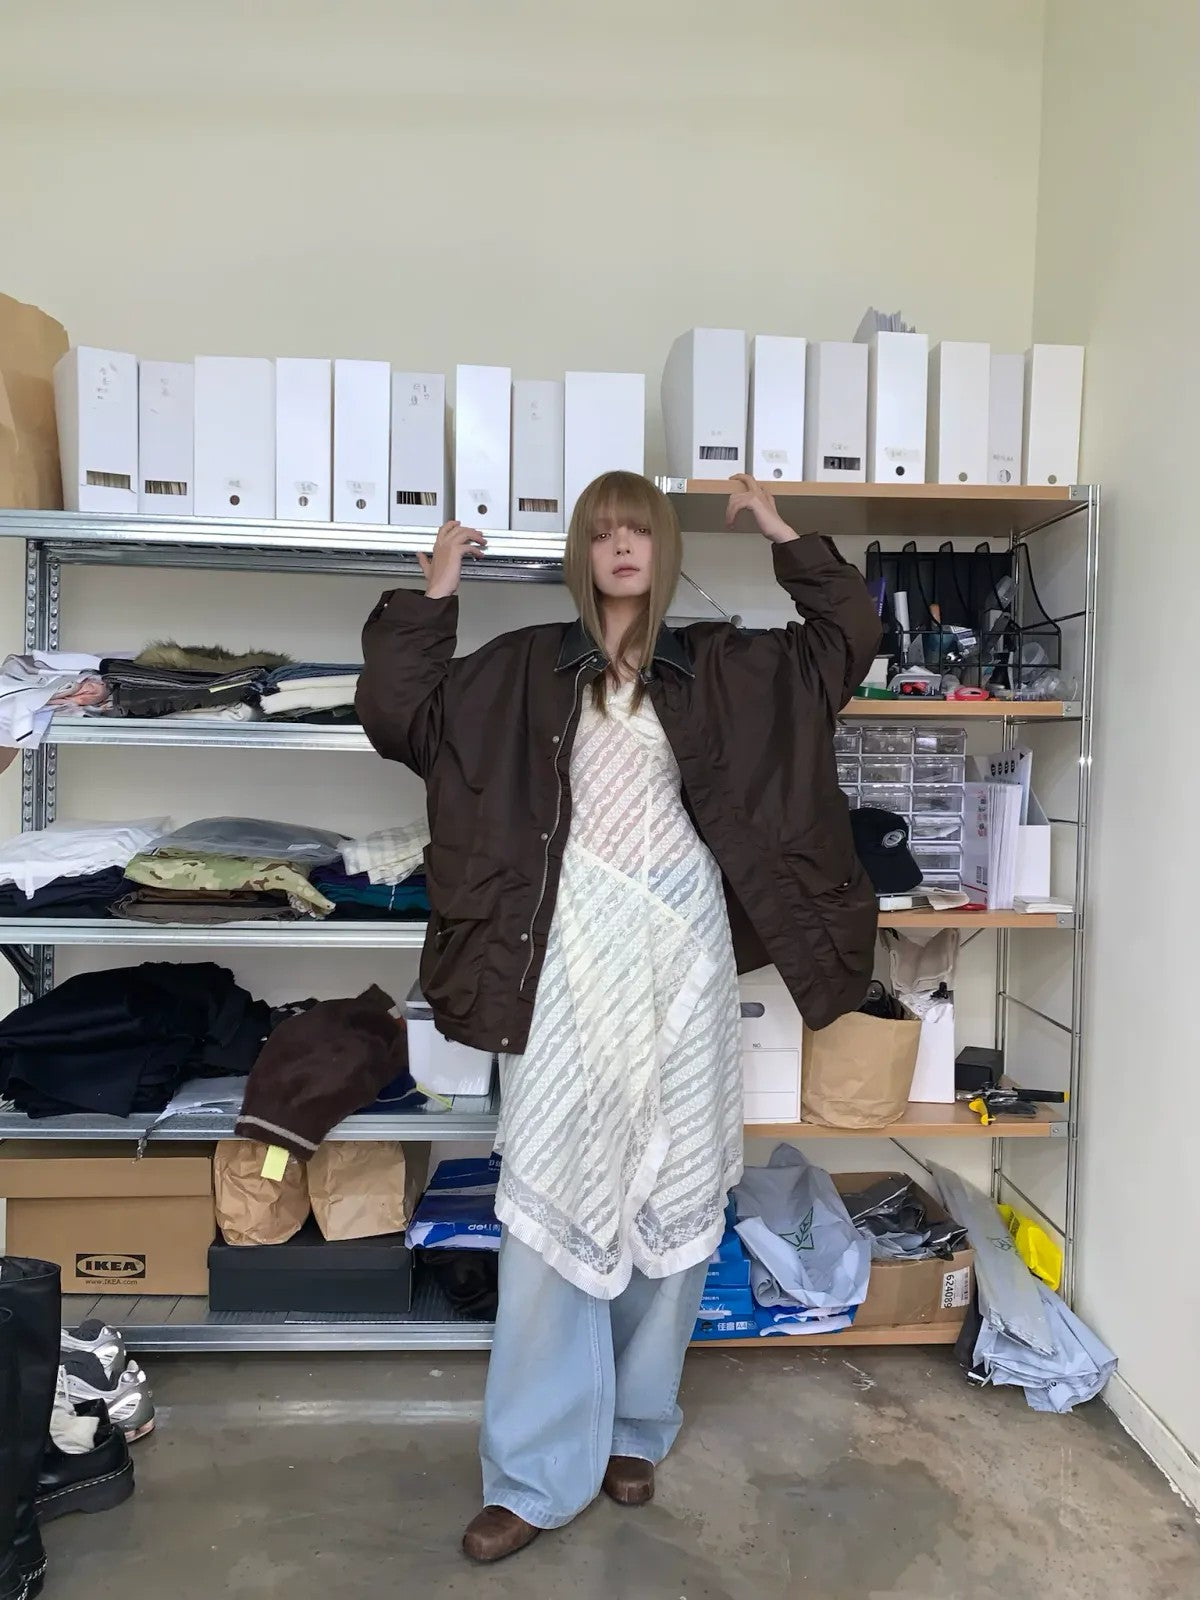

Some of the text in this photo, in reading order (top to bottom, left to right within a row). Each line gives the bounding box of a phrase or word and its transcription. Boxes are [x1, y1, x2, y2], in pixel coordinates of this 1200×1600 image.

[85, 1261, 138, 1271] IKEA
[943, 1274, 955, 1309] 624089
[736, 1321, 748, 1330] A4
